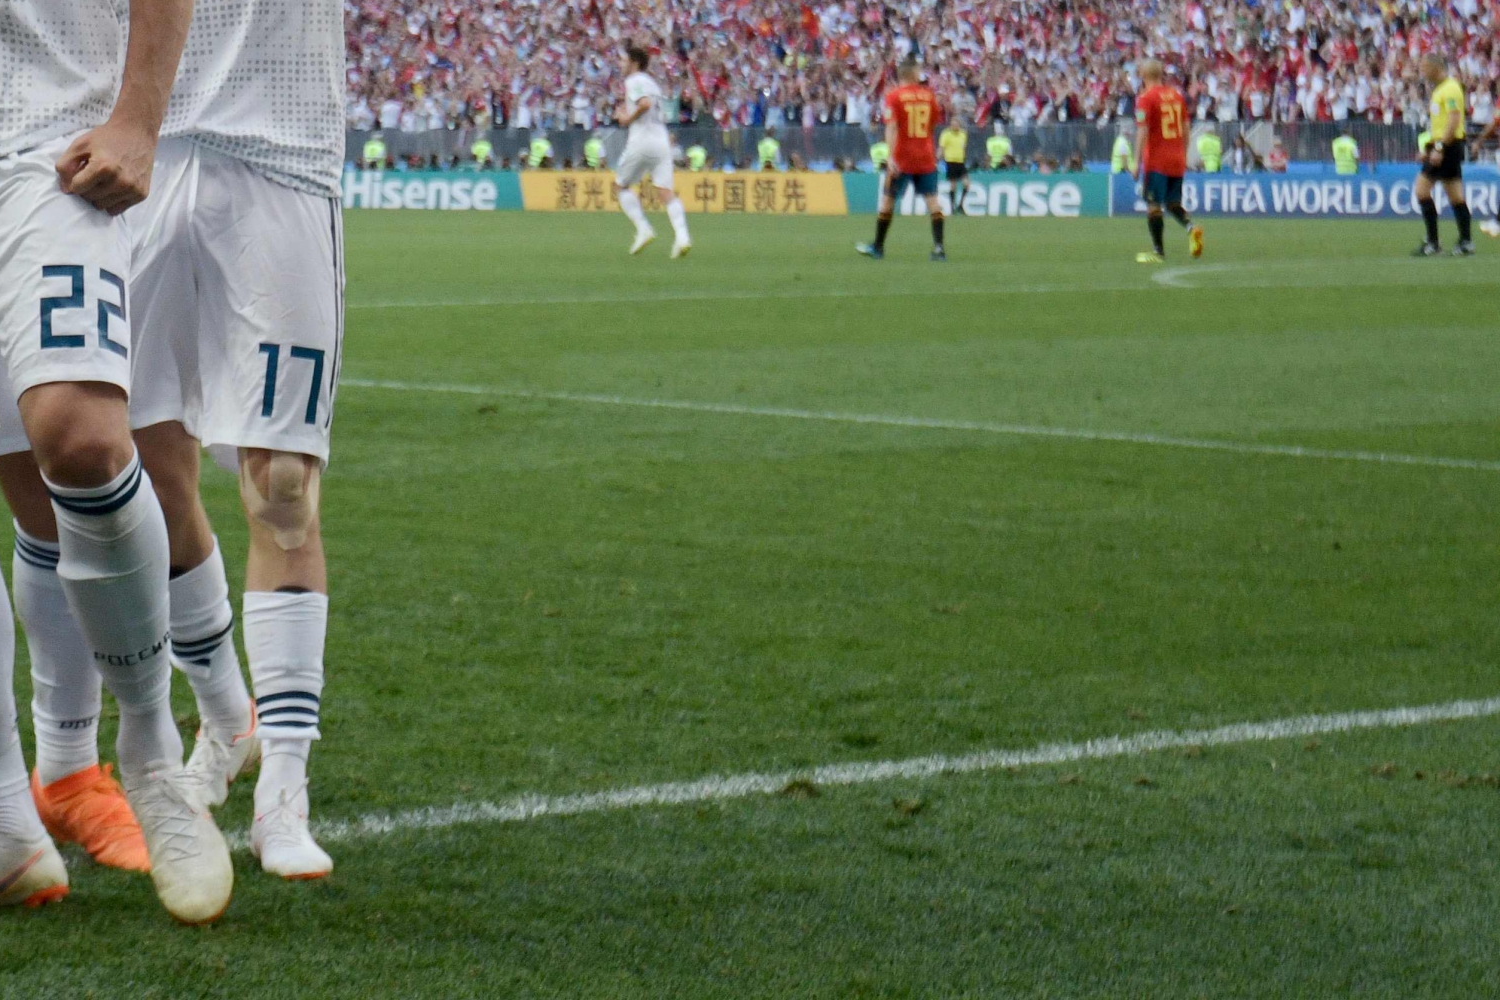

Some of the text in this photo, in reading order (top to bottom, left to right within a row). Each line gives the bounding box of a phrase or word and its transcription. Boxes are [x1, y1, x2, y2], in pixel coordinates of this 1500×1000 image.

[904, 102, 930, 138] 18
[1160, 102, 1182, 139] 21
[343, 171, 498, 211] Hisense
[692, 177, 807, 212] 中国领先
[1203, 180, 1266, 213] FIFA
[1270, 179, 1383, 214] WORLD
[40, 264, 127, 359] 22
[258, 343, 325, 424] 17
